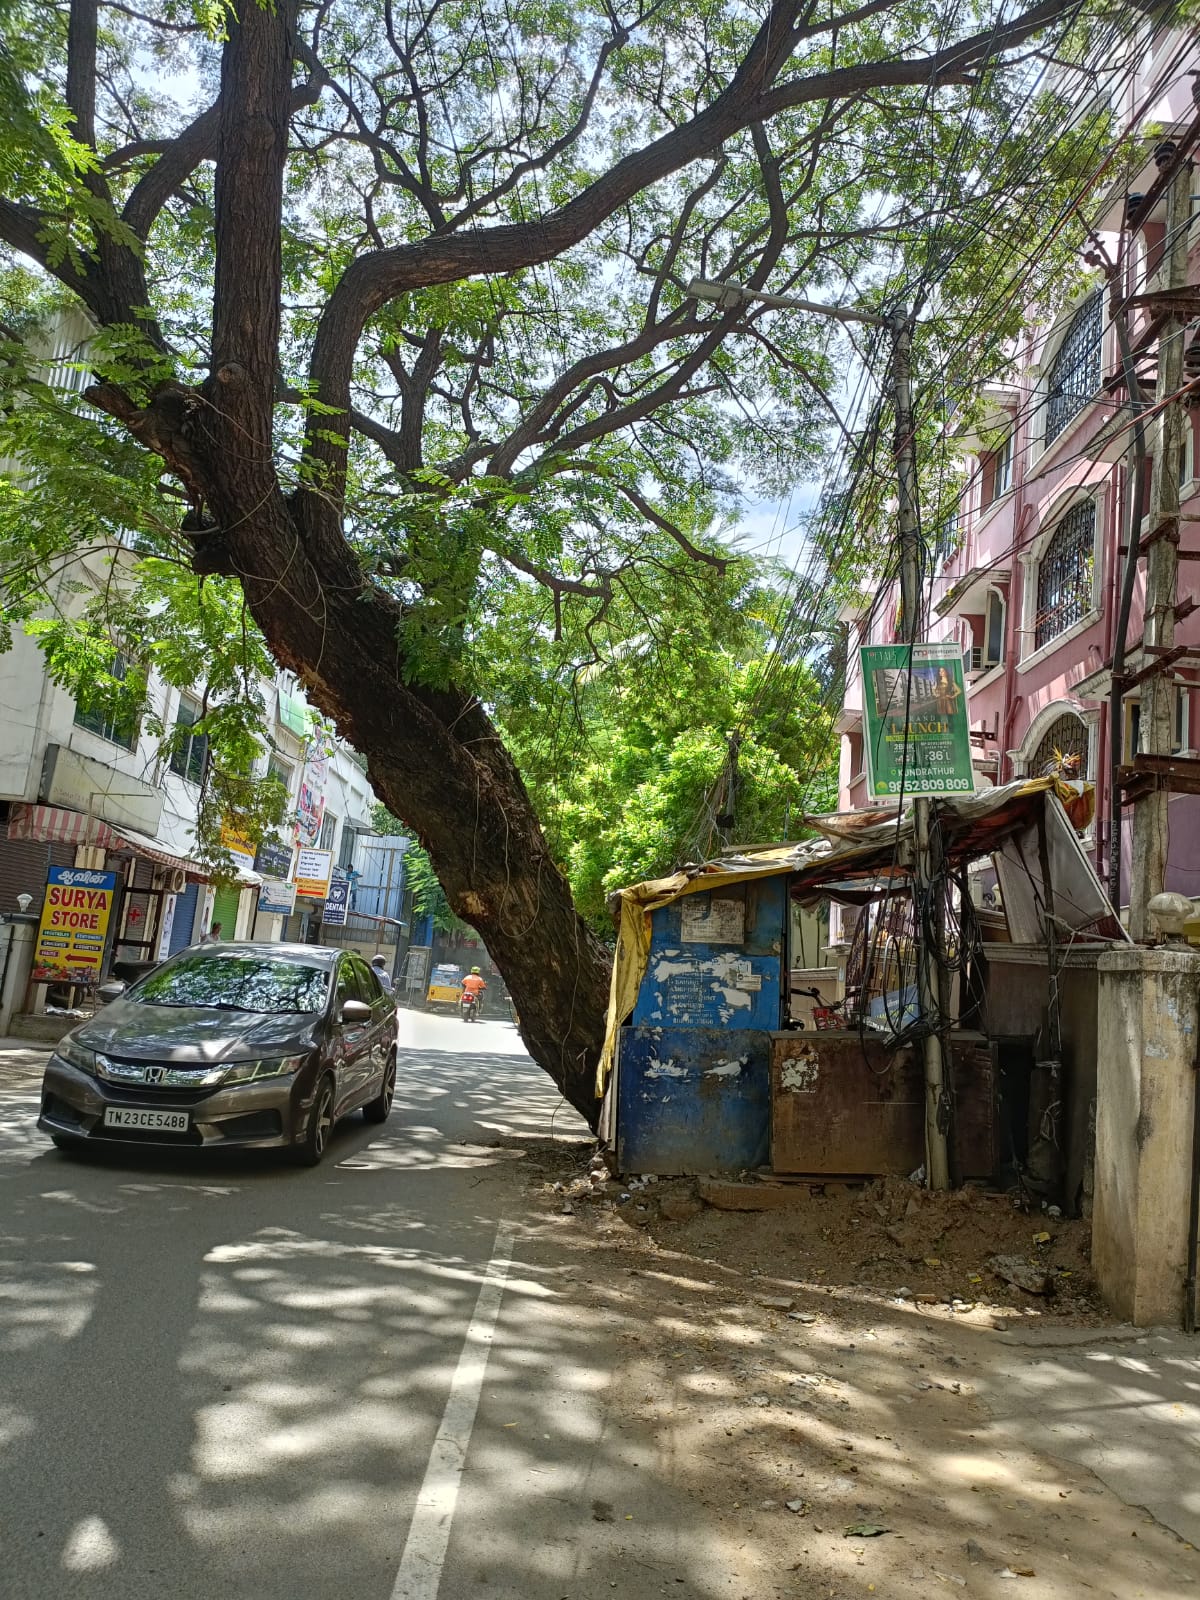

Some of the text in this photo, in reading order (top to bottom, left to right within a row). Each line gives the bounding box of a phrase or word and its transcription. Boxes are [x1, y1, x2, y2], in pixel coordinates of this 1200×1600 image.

[921, 779, 944, 791] 809
[946, 778, 969, 790] 809
[58, 870, 107, 885] ஆவின்
[49, 887, 107, 910] SURYA
[325, 902, 345, 912] DENTAL
[51, 910, 99, 929] STORE
[108, 1111, 185, 1128] TN23CE5488
